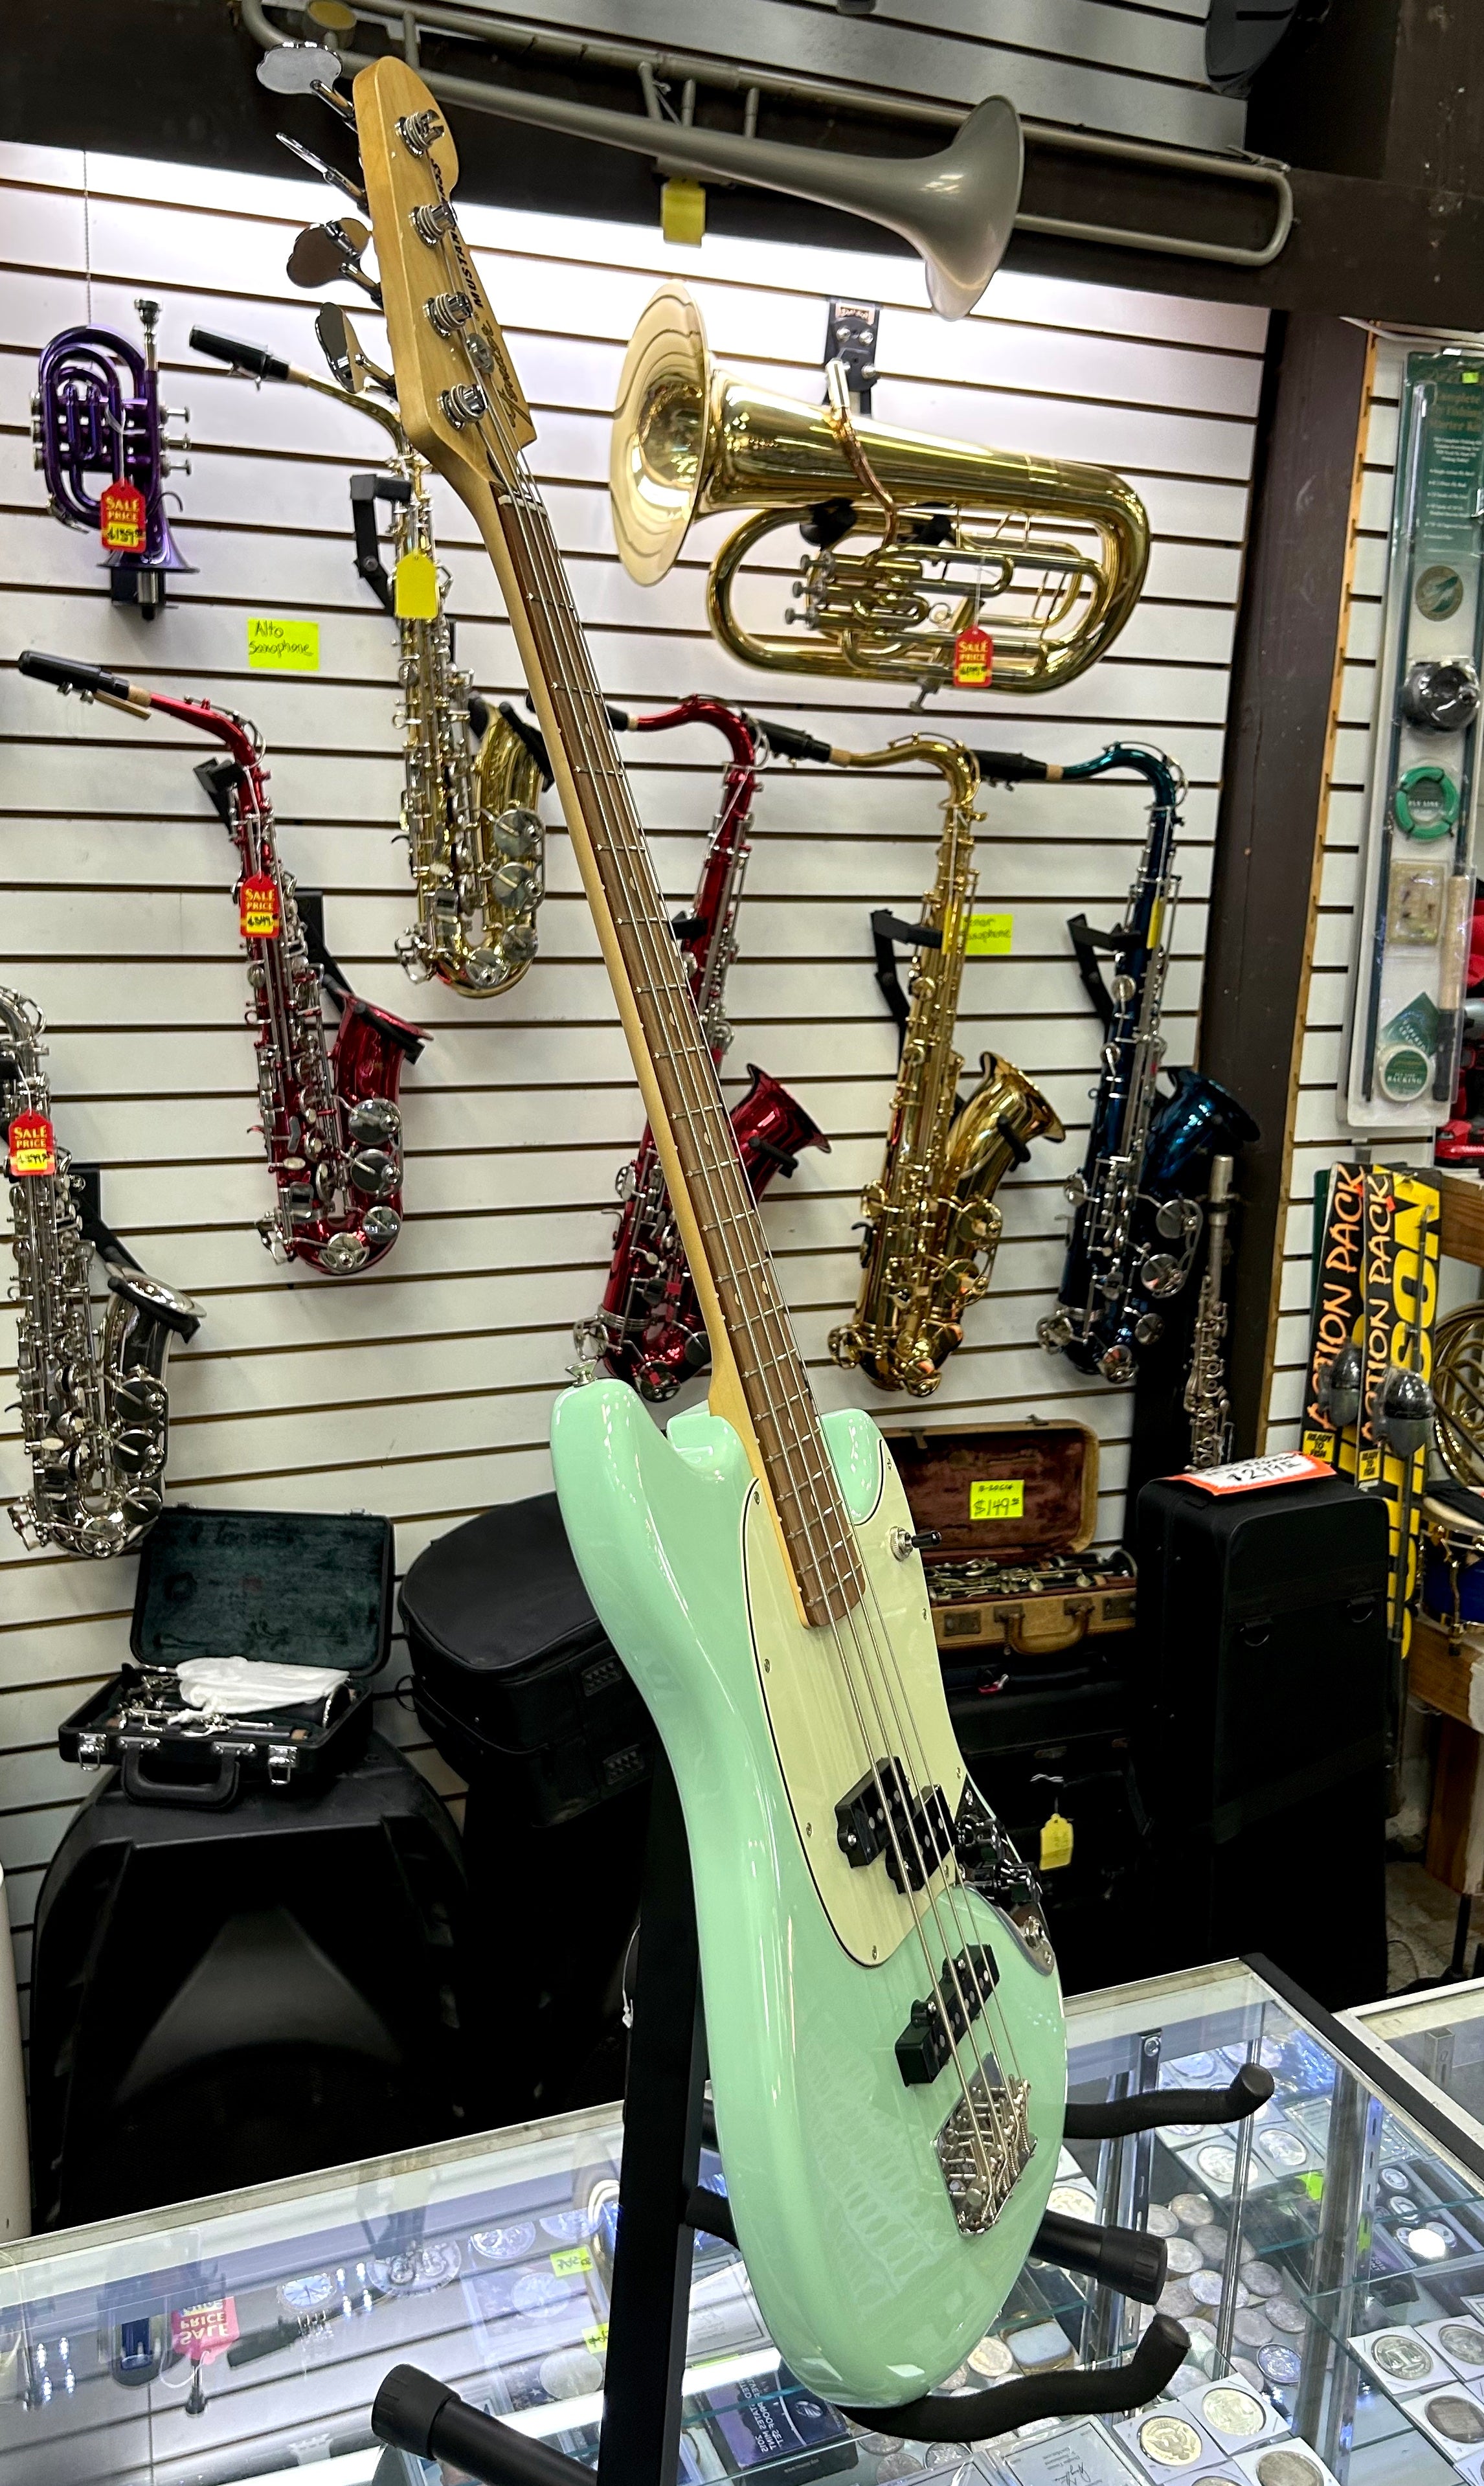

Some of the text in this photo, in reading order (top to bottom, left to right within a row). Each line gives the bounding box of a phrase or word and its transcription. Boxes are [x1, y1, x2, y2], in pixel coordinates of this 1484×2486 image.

[450, 225, 484, 309] MUSTAN
[106, 496, 141, 512] SALE
[107, 510, 140, 523] PRICE
[254, 620, 284, 638] Alto
[958, 638, 989, 653] SALE
[245, 888, 275, 902] SALE
[246, 901, 274, 911] PRICE
[14, 1124, 48, 1140] SALE
[16, 1138, 47, 1149] PRICE
[1325, 1162, 1365, 1274] PACK
[1367, 1175, 1393, 1285] PACK
[1314, 1440, 1325, 1449] TO
